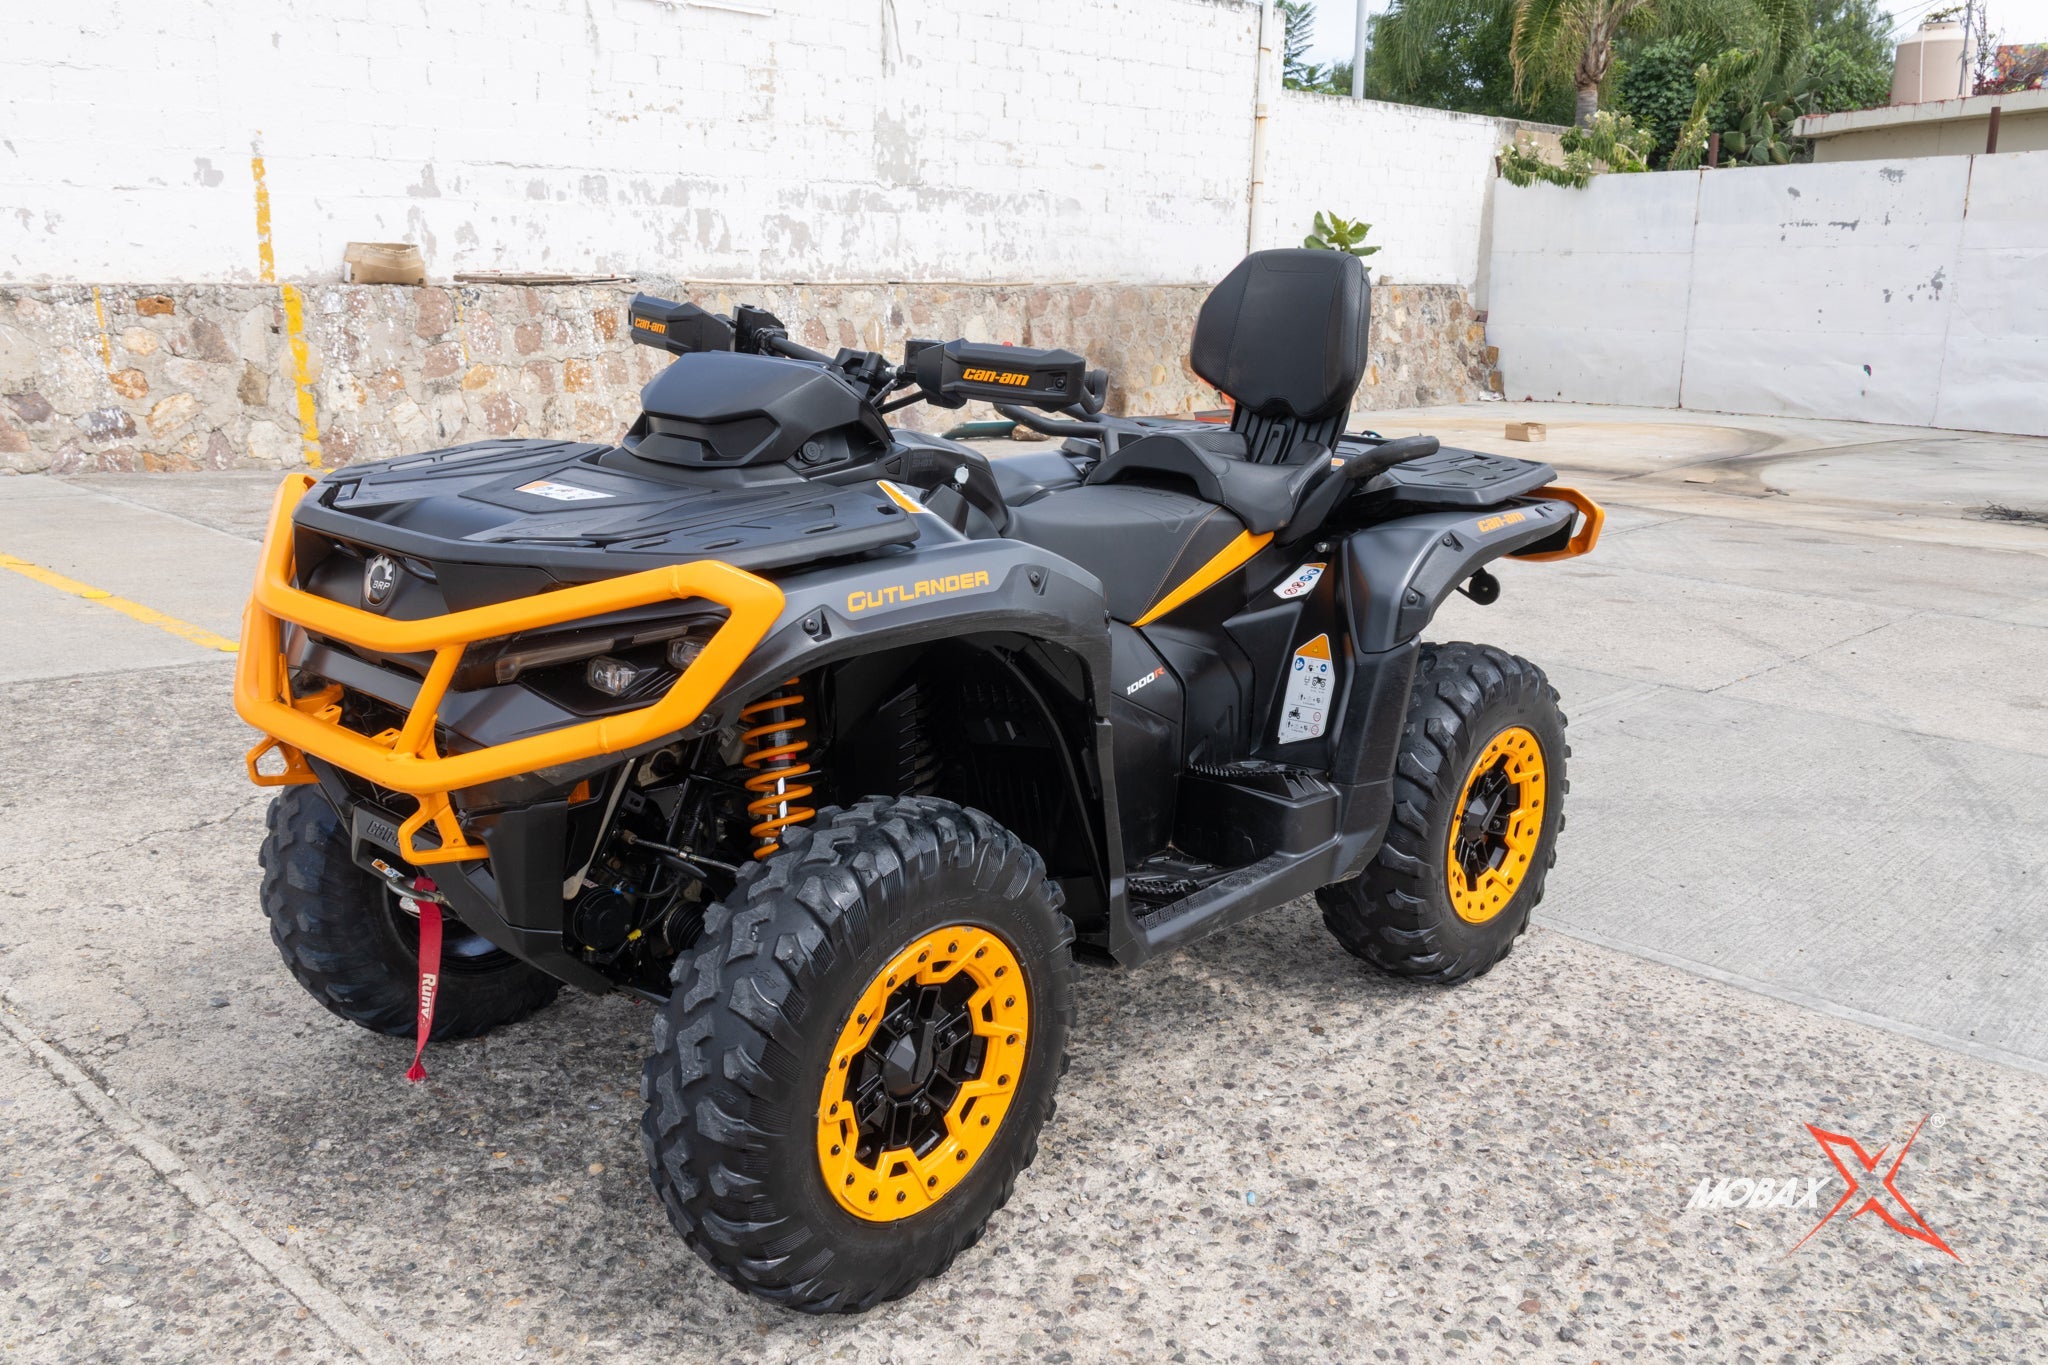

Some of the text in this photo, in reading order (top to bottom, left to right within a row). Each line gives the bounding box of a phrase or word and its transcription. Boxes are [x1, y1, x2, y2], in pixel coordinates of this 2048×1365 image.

[635, 318, 666, 334] can-am
[963, 368, 1030, 386] can-am
[1477, 512, 1526, 532] can-am
[372, 580, 391, 590] BRP
[847, 570, 990, 612] OUTLANDER
[1126, 667, 1165, 695] 1000R
